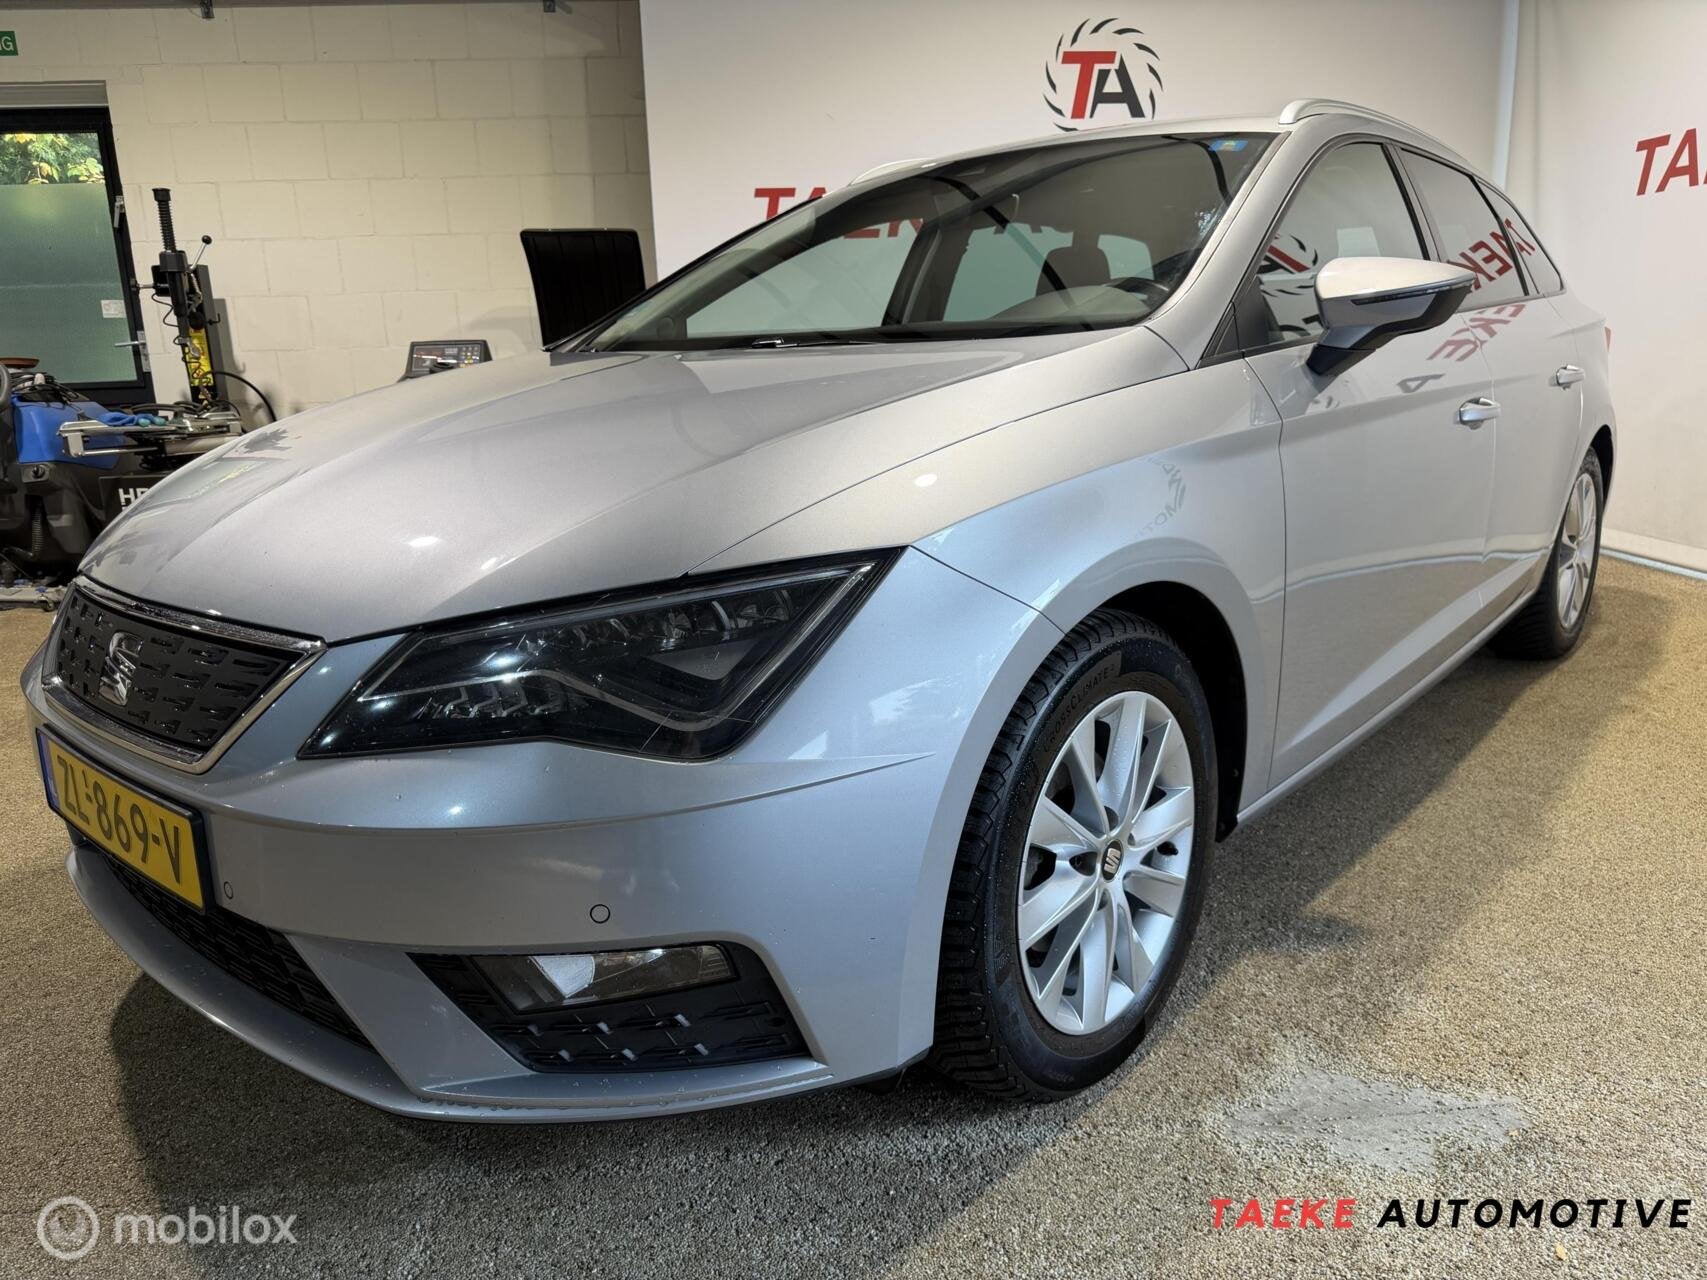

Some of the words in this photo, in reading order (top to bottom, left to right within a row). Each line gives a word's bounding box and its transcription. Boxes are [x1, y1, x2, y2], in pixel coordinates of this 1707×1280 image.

[0, 36, 14, 51] G
[1061, 50, 1146, 119] TA
[1635, 127, 1707, 196] TA
[57, 754, 181, 885] ZL-869-V
